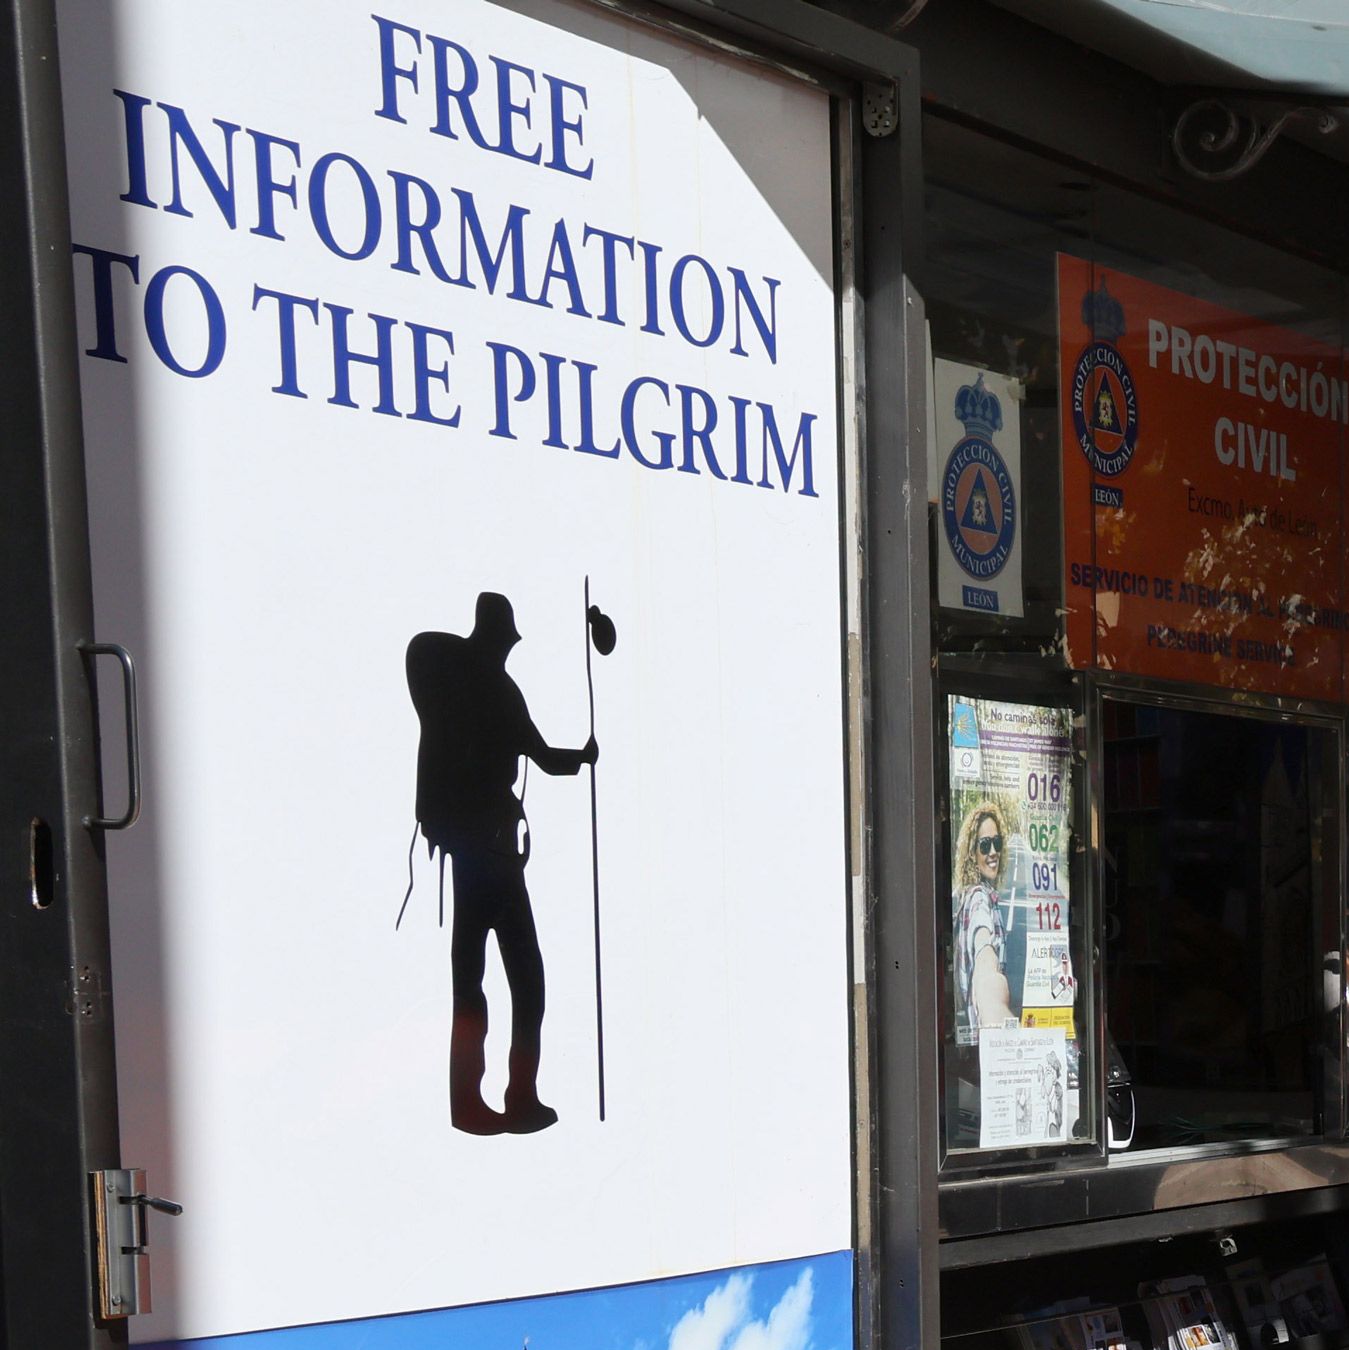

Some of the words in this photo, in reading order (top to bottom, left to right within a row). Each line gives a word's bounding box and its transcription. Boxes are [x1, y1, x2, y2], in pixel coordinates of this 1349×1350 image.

[371, 13, 595, 181] FREE
[113, 89, 781, 365] INFORMATION
[72, 243, 227, 379] TO
[252, 283, 462, 428] THE
[487, 341, 820, 498] PILGRIM
[1148, 318, 1349, 425] PROTECCIÓN
[1214, 416, 1297, 481] CIVIL
[998, 471, 1013, 525] CIVIL
[1094, 488, 1119, 507] LEÓN
[951, 533, 1008, 576] MUNICIPAL
[967, 589, 994, 609] LEÓN
[1071, 562, 1148, 597] SERVICIO
[1153, 576, 1173, 600] DE
[1028, 773, 1060, 802] 016
[1029, 823, 1058, 852] 062
[1032, 862, 1057, 890] 091
[1036, 902, 1062, 930] 112
